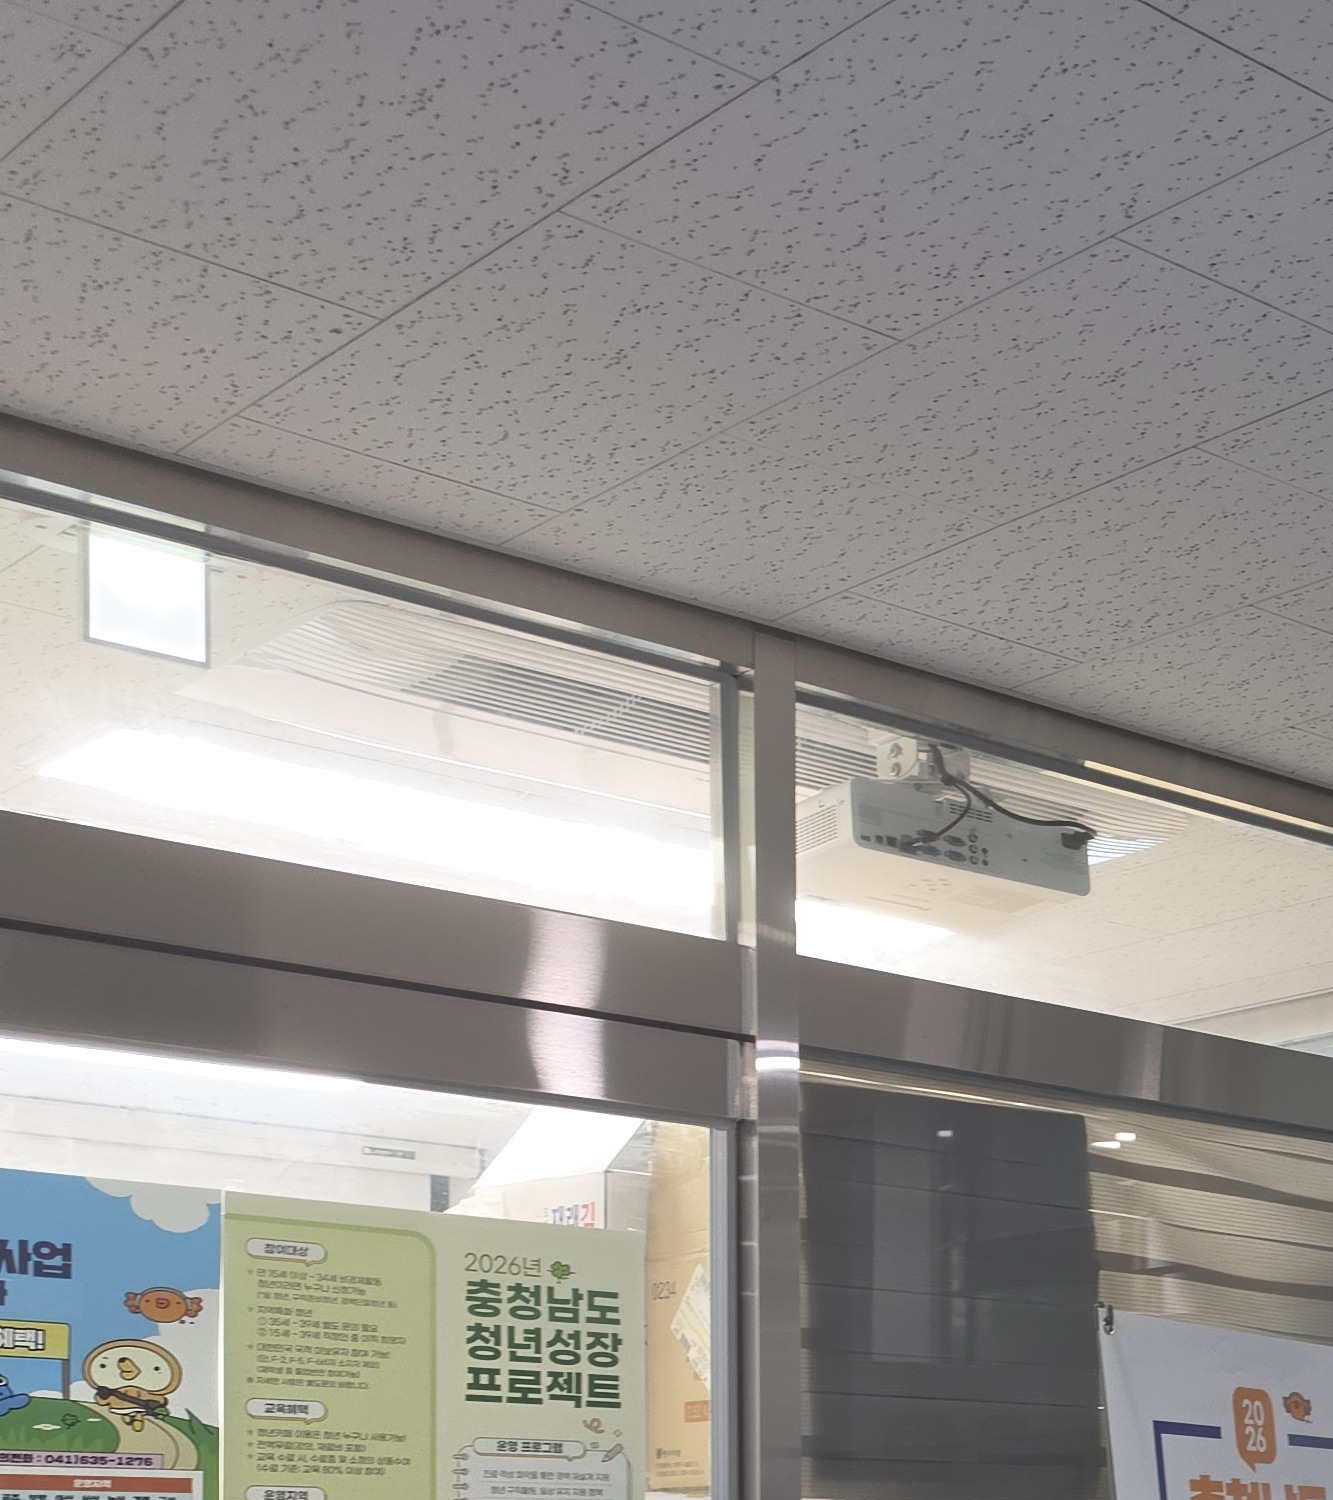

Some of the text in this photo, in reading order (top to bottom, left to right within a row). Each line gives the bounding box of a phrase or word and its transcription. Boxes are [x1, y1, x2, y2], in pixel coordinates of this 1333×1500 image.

[464, 1253, 541, 1277] 2026년
[465, 1279, 621, 1325] 충청남도
[465, 1323, 623, 1368] 청년성장
[465, 1367, 622, 1409] 프로젝트
[1241, 1399, 1265, 1427] 20
[496, 1440, 563, 1453] 운영 프로그램
[1245, 1425, 1267, 1452] 26
[44, 1454, 153, 1466] 041)635-1276
[264, 1490, 309, 1500] 운영지역
